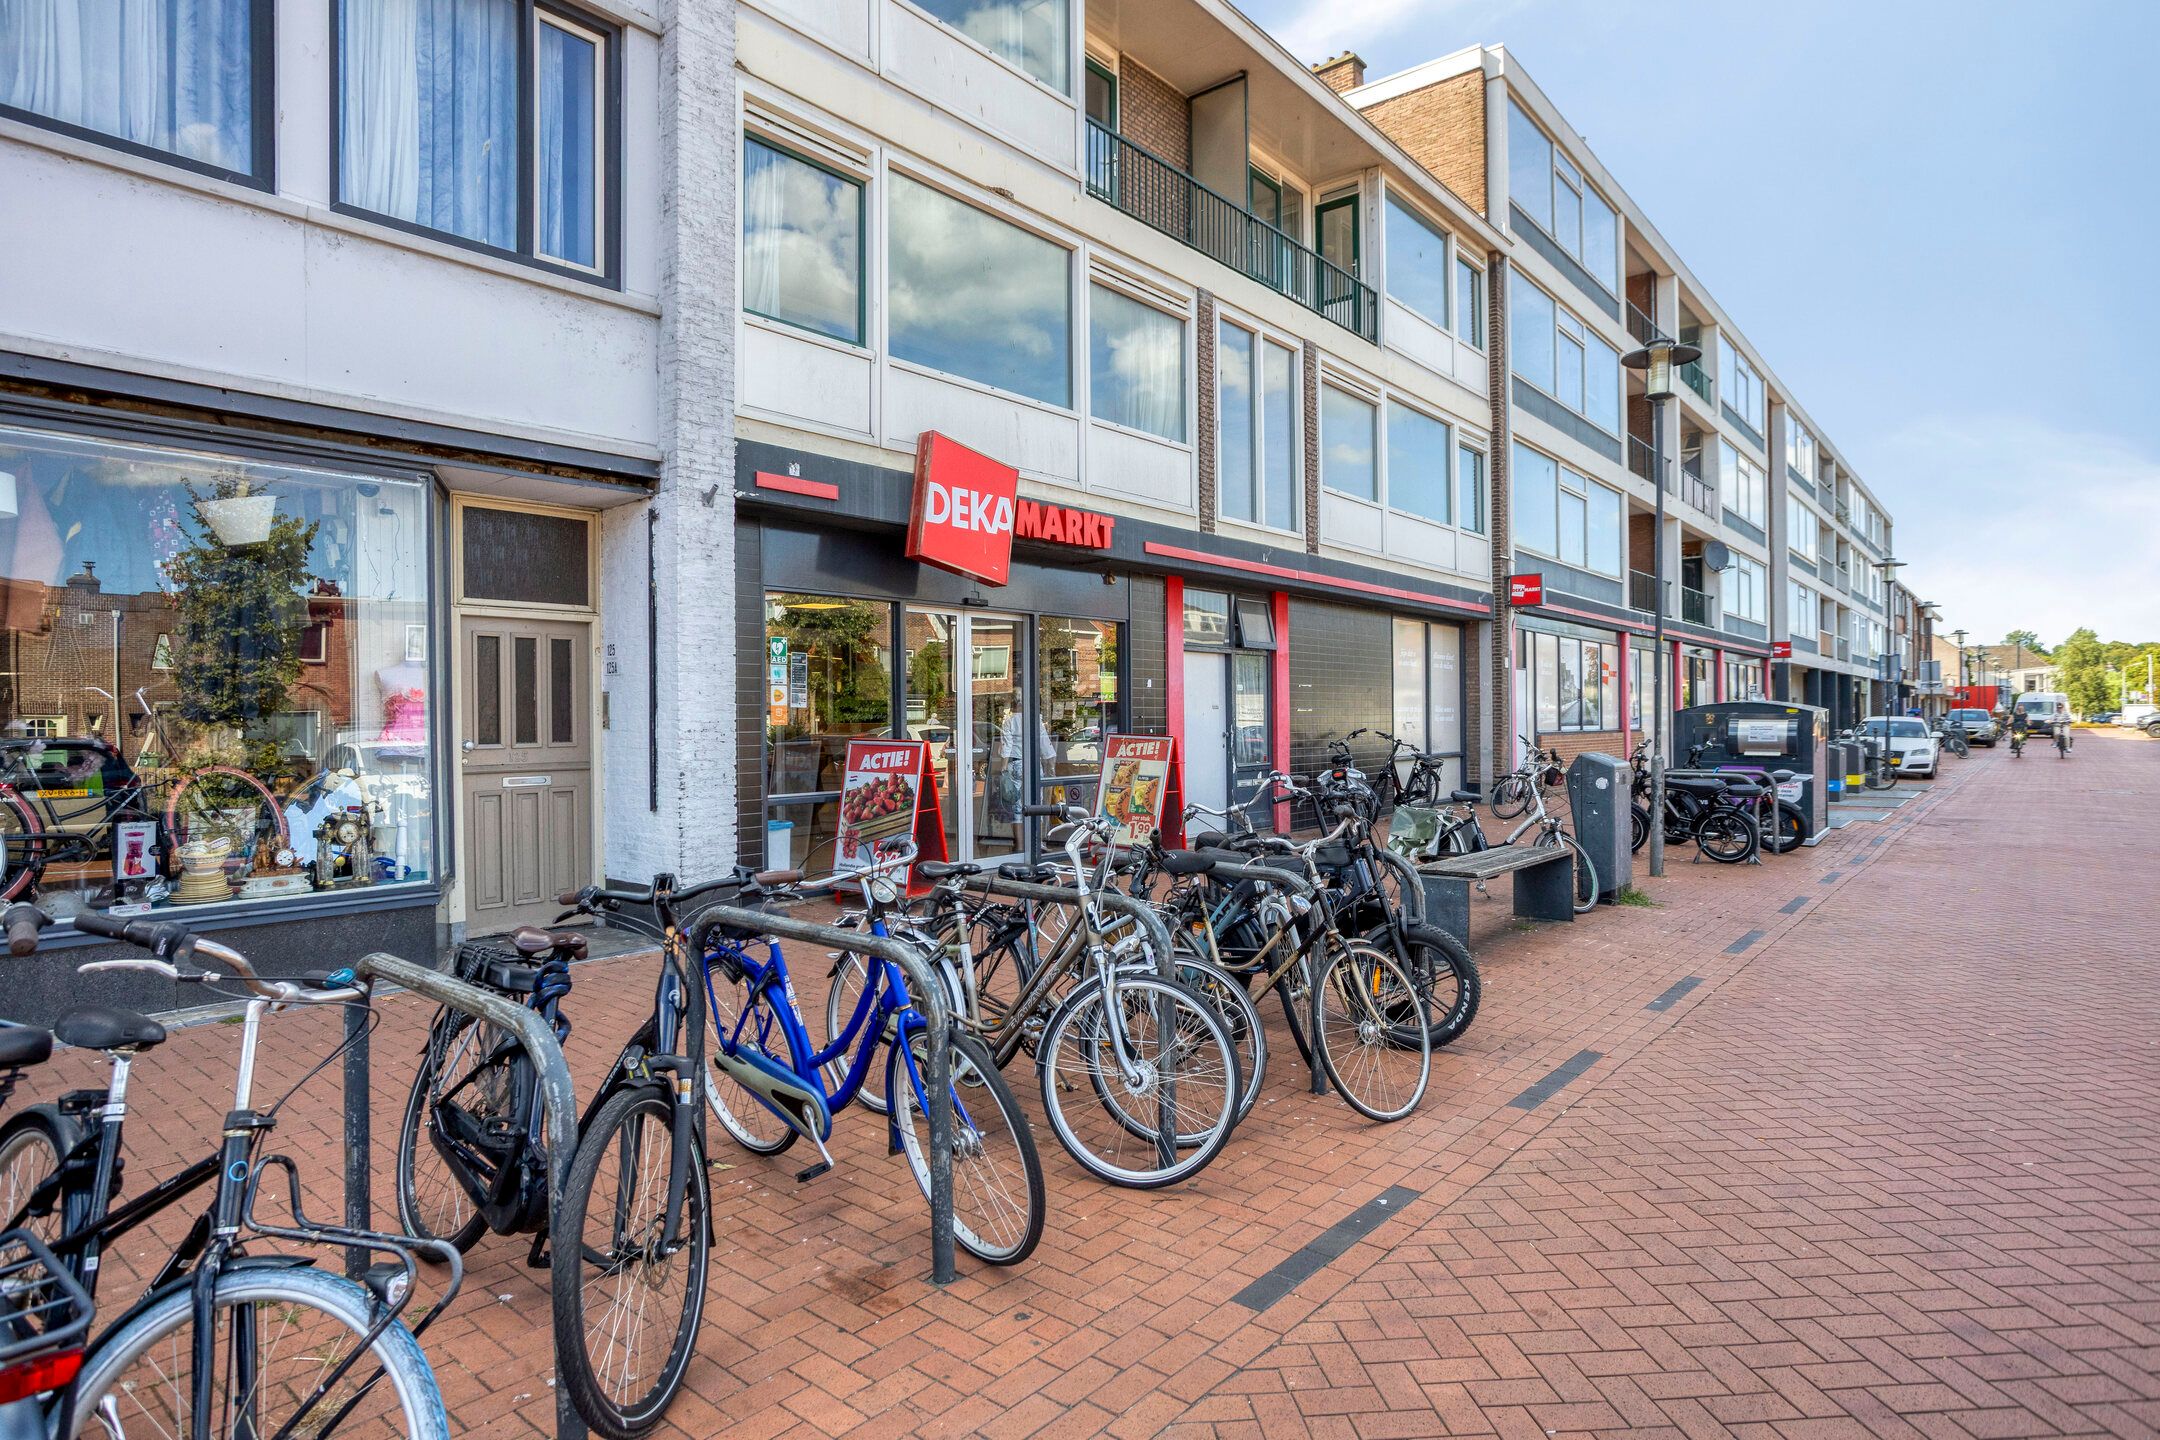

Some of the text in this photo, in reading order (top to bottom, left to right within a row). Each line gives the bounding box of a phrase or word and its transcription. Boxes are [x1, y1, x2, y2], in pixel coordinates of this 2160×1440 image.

[925, 481, 1115, 549] DEKA MARKT
[607, 643, 616, 656] 125
[1116, 741, 1160, 757] ACTIE!
[859, 750, 911, 771] ACTIE!
[1129, 822, 1150, 839] 1.99
[1010, 967, 1061, 1028] BATAVUS
[1447, 978, 1471, 1030] KENDA
